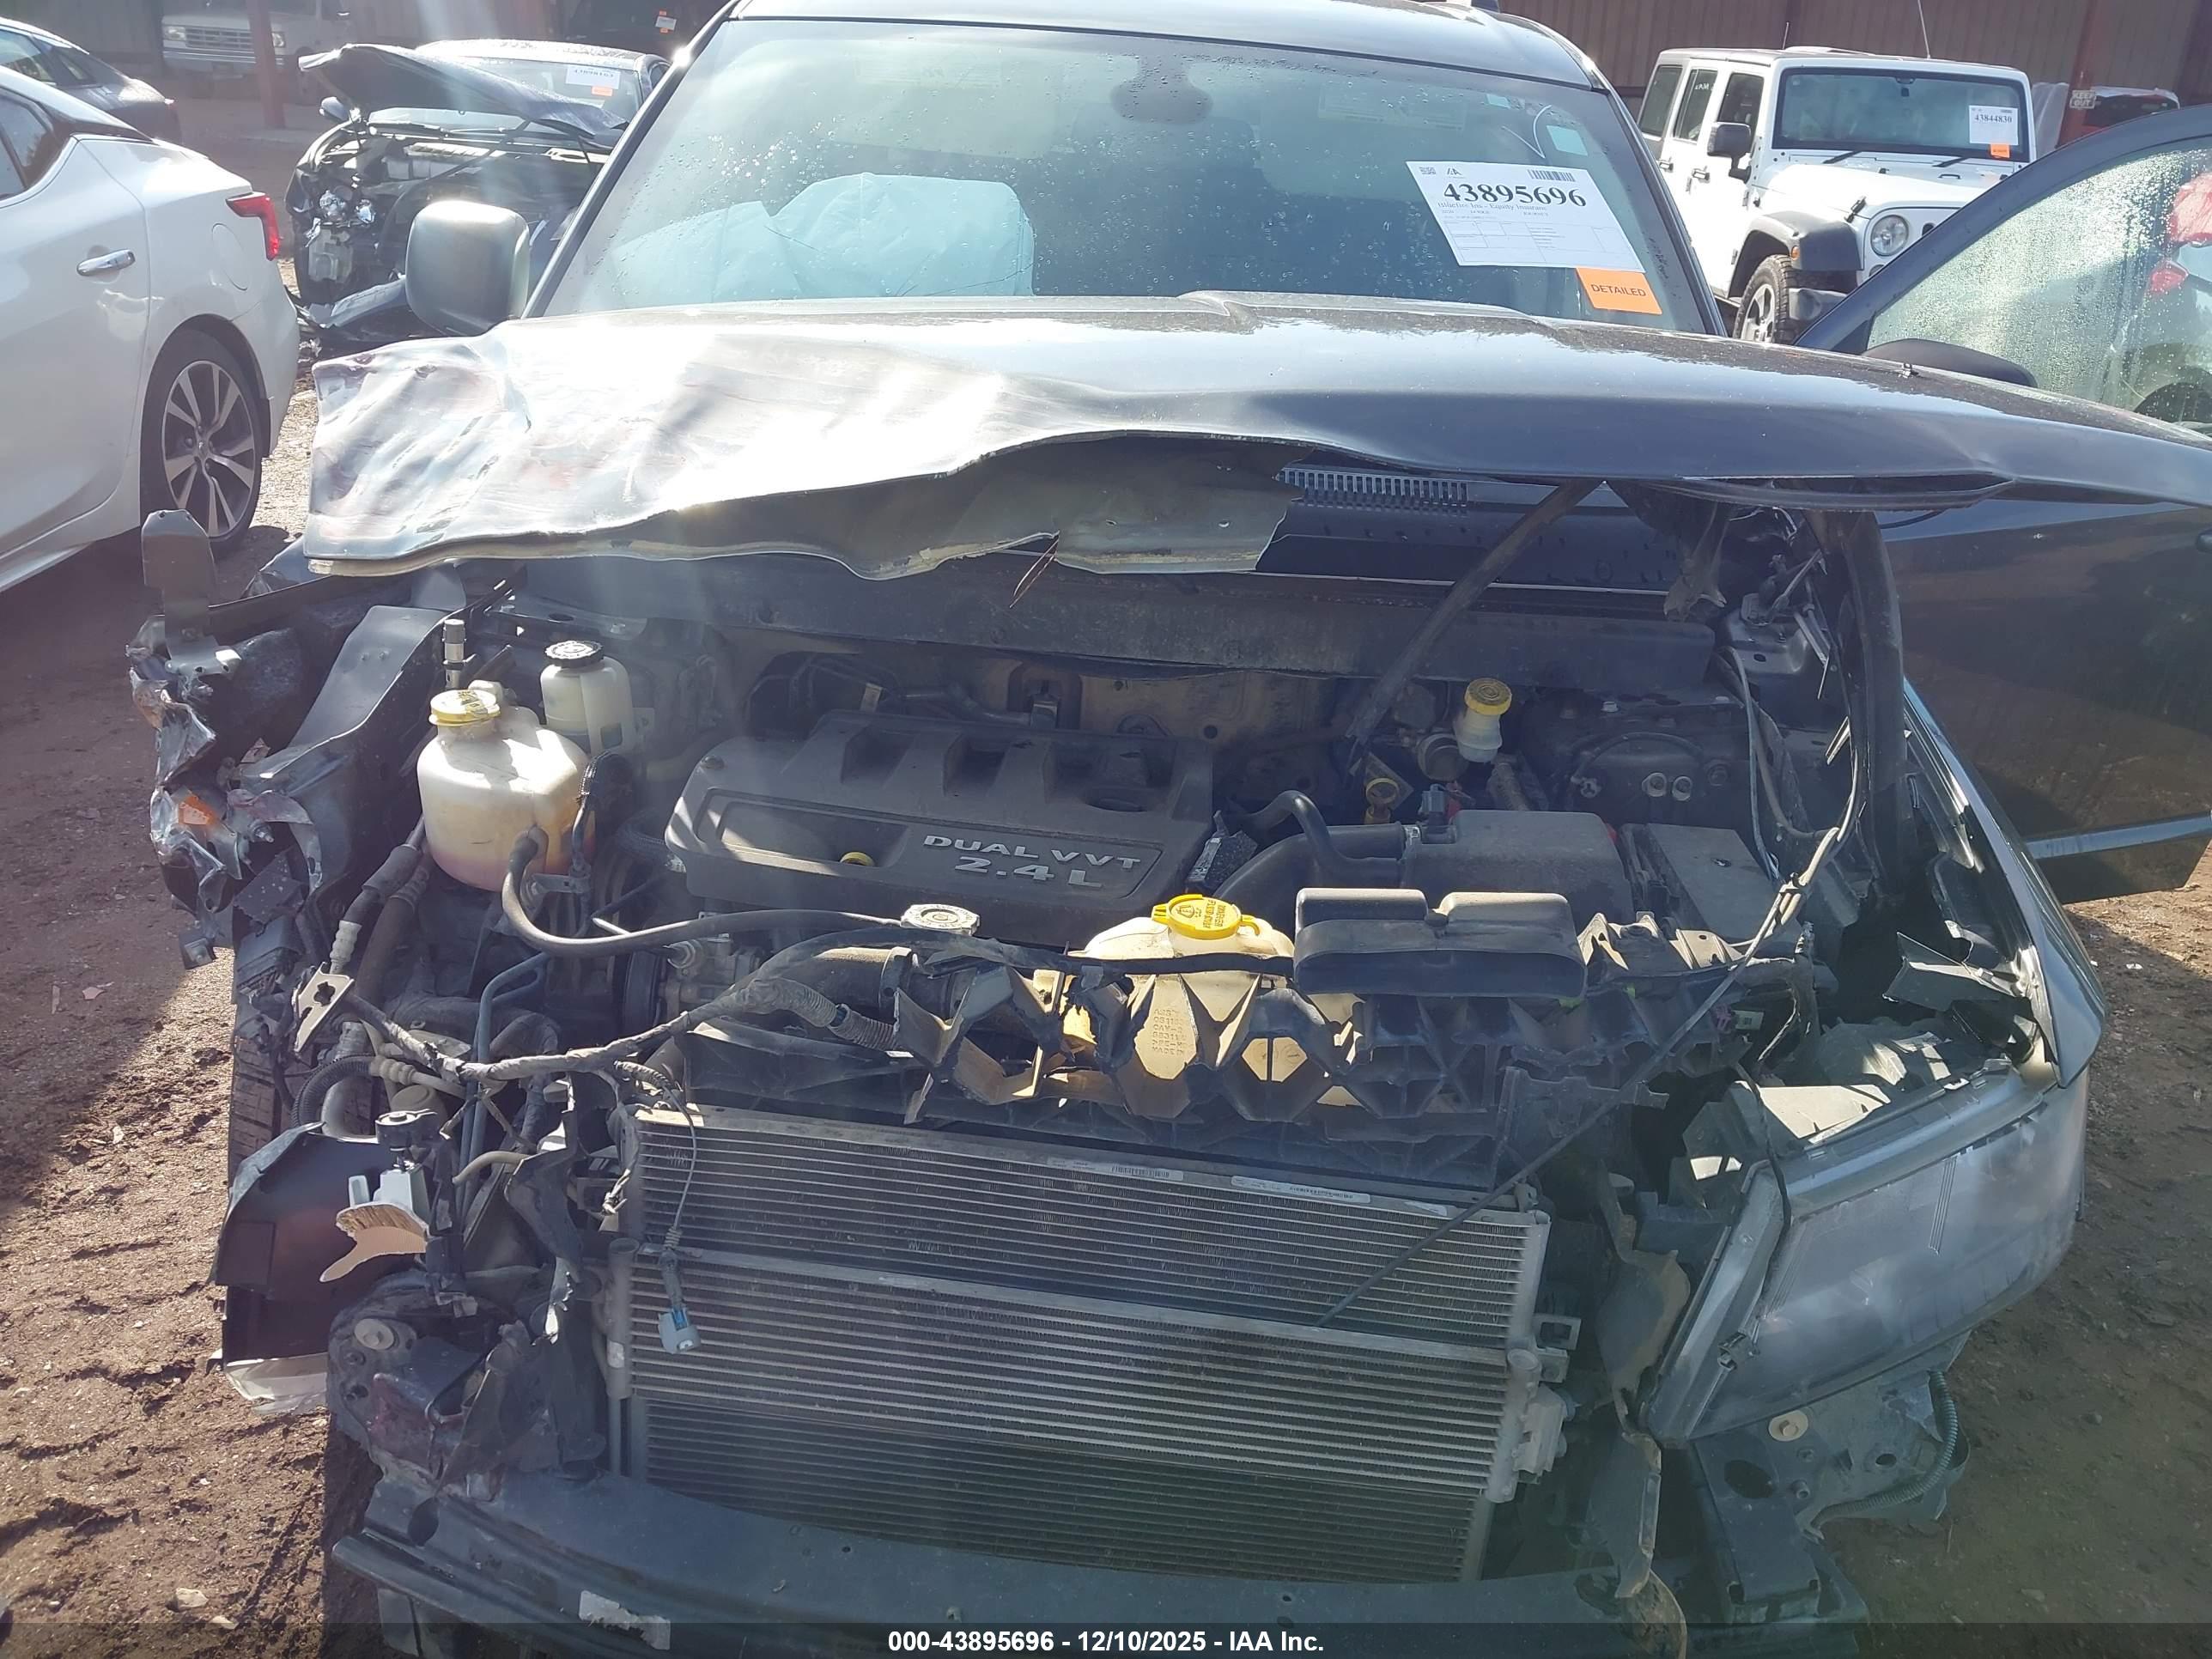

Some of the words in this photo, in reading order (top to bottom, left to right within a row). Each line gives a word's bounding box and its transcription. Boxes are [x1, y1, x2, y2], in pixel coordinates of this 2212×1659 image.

[1975, 113, 2013, 123] 43844830
[1443, 183, 1587, 207] 43895696
[1590, 284, 1647, 296] DETAILED
[923, 835, 1039, 859] DUAL
[1050, 849, 1141, 870] VVT
